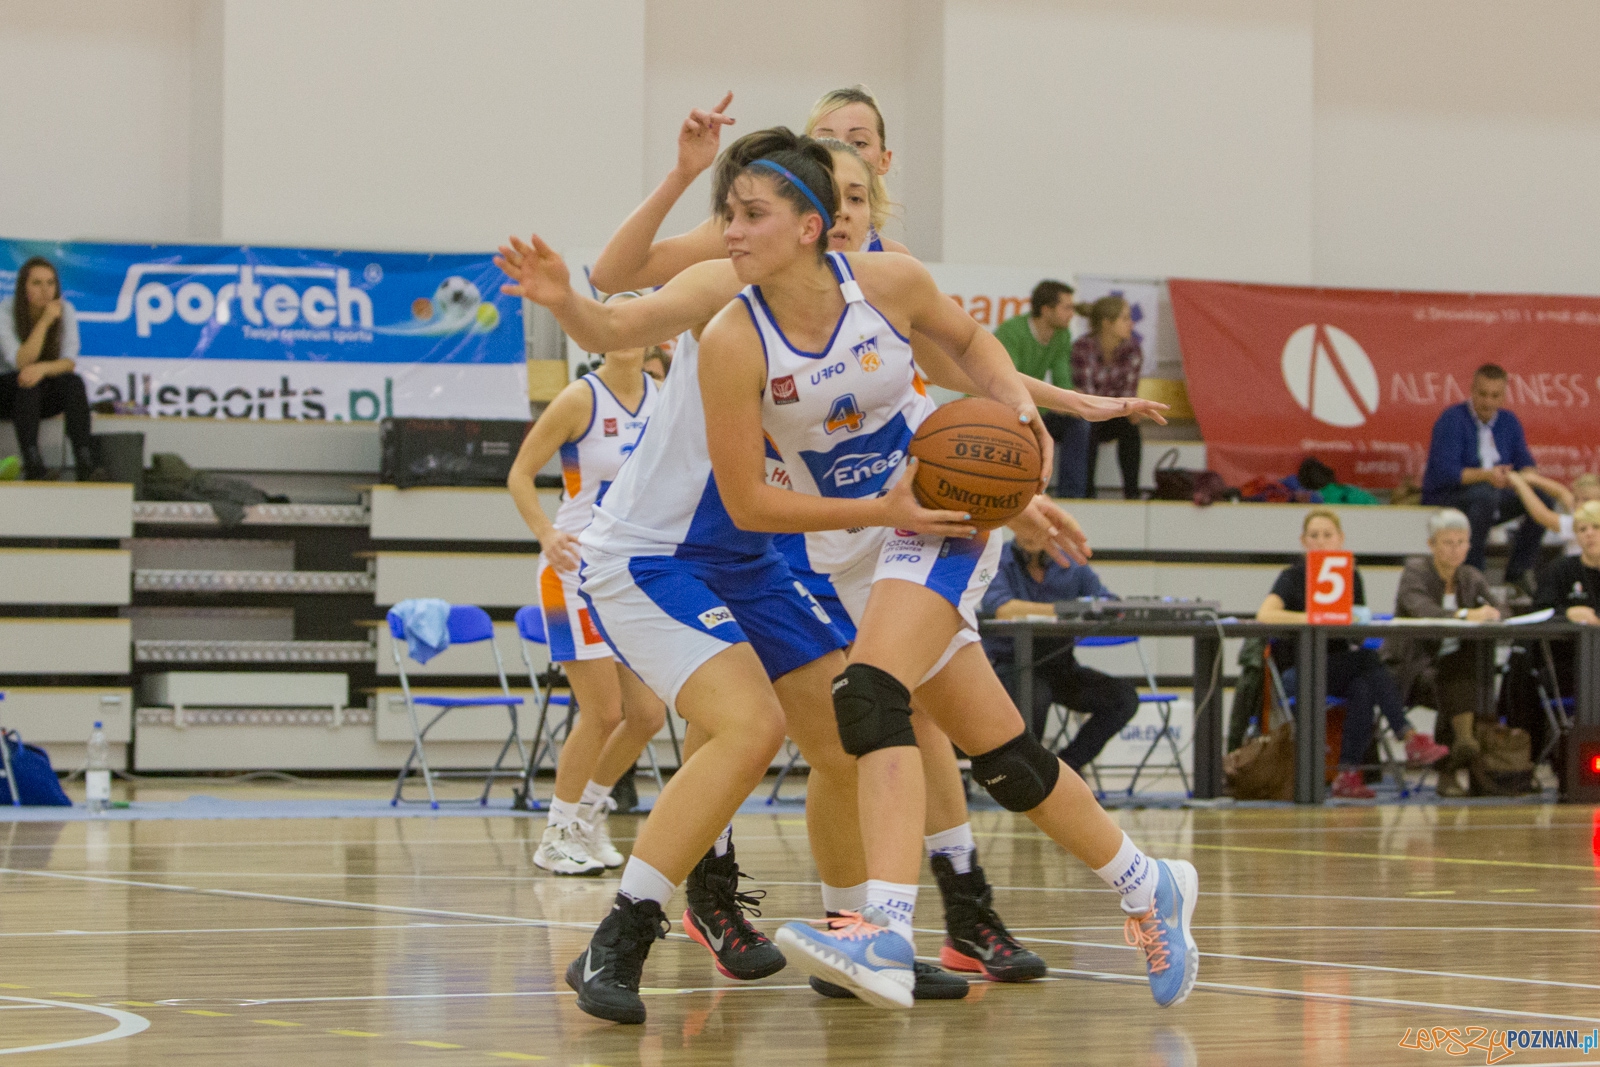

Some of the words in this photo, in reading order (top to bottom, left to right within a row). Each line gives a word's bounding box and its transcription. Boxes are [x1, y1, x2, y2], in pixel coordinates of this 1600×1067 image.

[824, 393, 866, 435] 4
[834, 450, 904, 488] Enea
[955, 441, 1022, 466] TF-250
[937, 478, 1022, 507] SPALDING
[1313, 557, 1348, 605] 5
